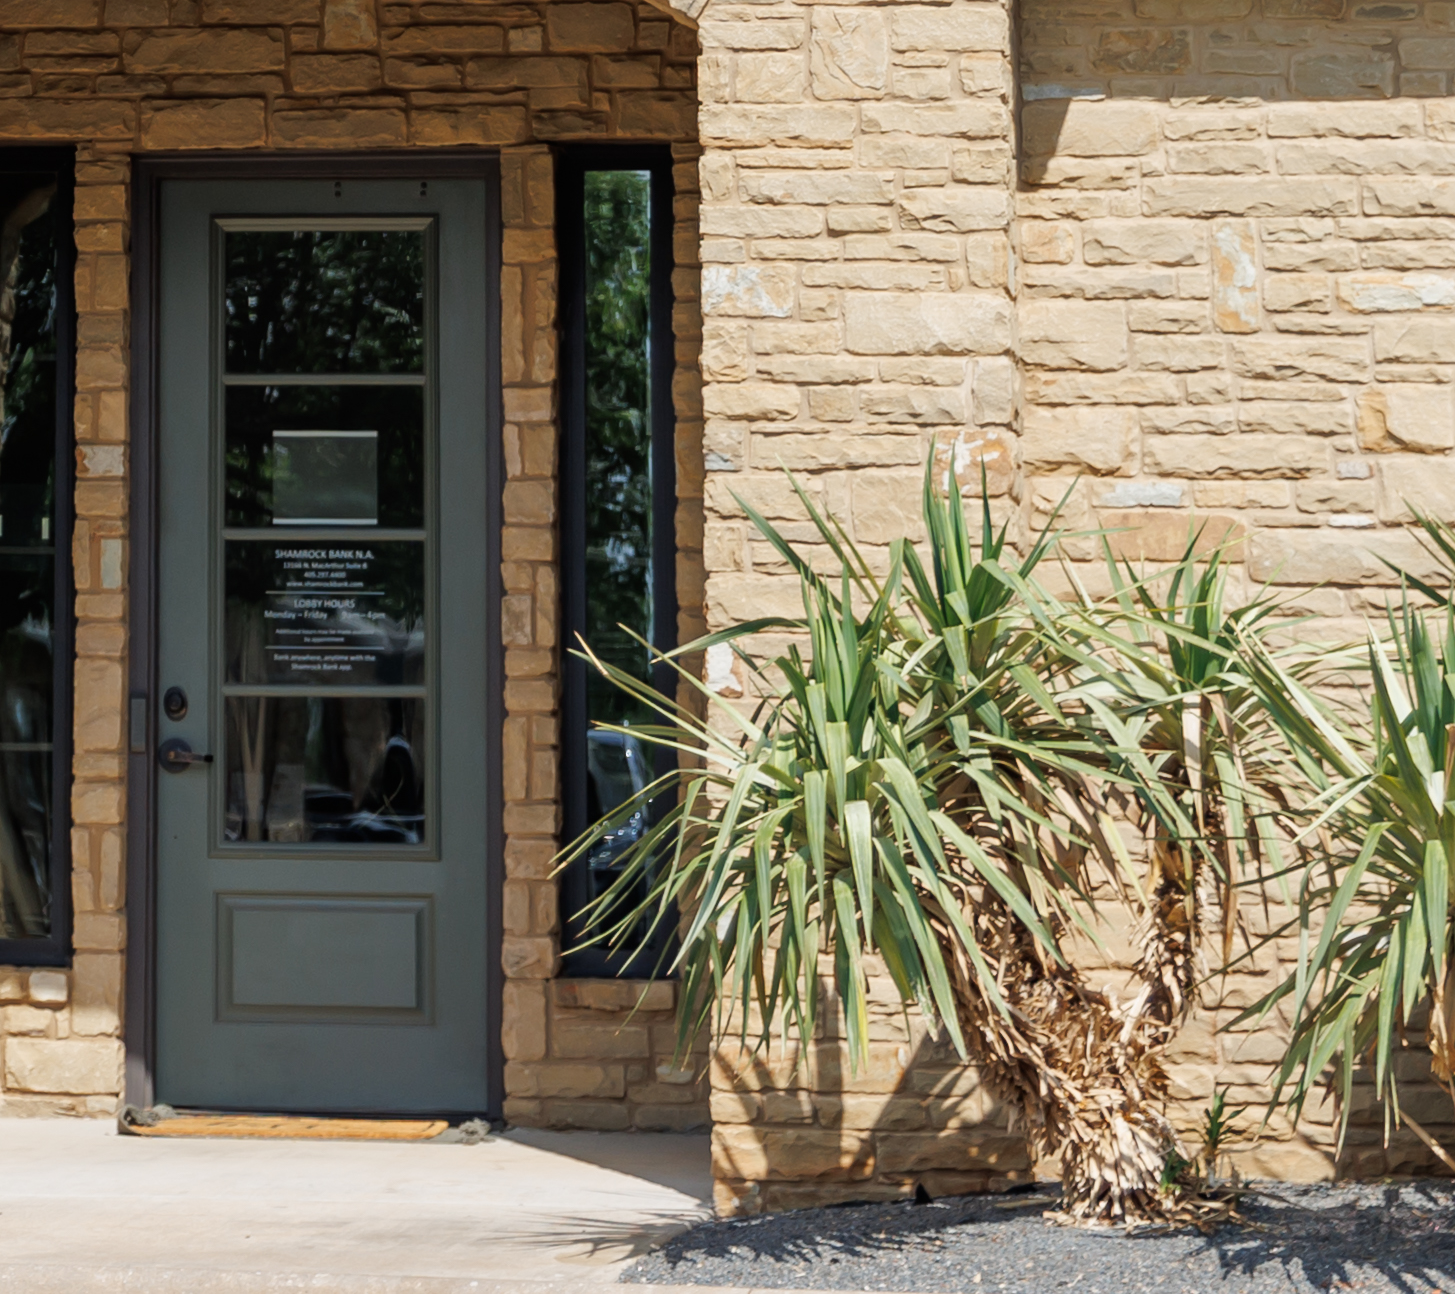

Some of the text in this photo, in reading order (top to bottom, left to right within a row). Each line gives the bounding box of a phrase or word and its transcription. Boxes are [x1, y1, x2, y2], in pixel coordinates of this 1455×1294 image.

[275, 549, 375, 560] SHAMROCK BANK N.A.
[294, 599, 356, 608] LOBBY HOURS
[264, 610, 296, 619] Monday
[304, 610, 328, 619] Friday
